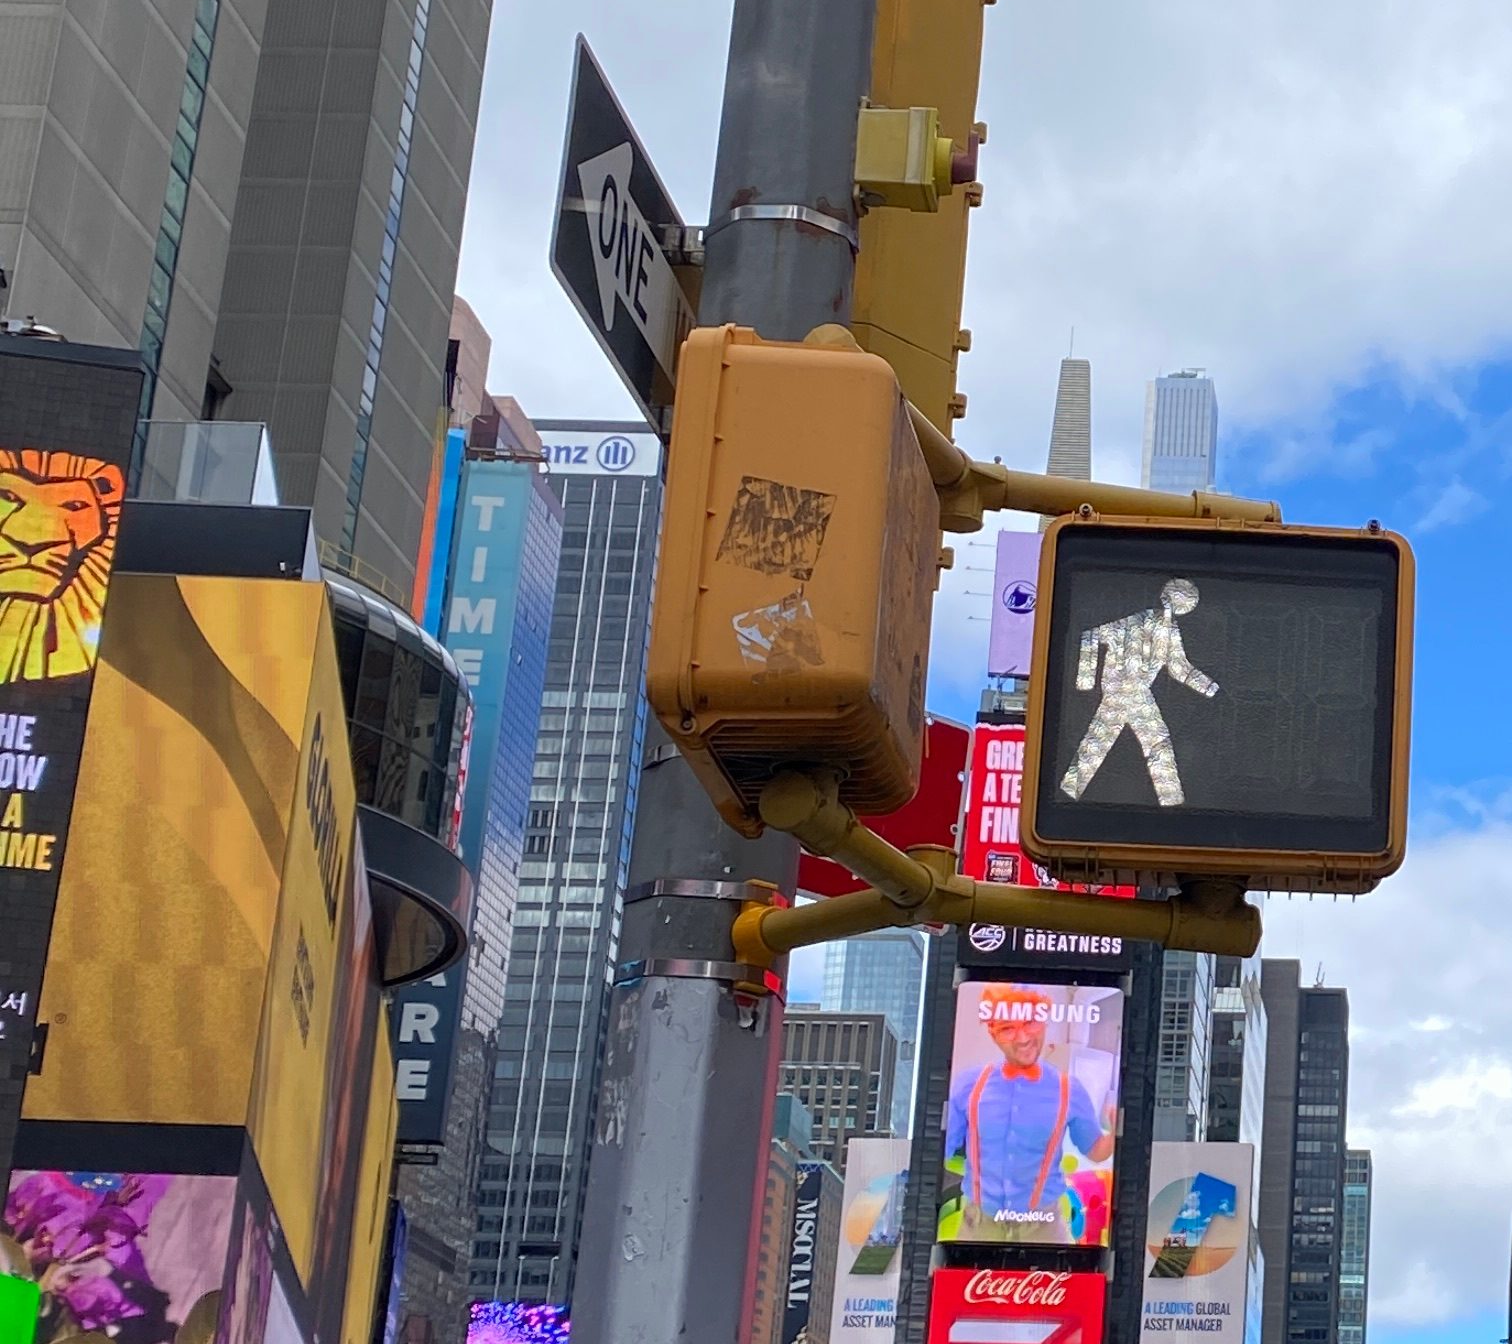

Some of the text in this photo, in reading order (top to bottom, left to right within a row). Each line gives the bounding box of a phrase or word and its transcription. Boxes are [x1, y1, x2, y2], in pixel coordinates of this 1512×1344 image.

[600, 174, 655, 325] ONE
[0, 713, 37, 752] HE
[986, 740, 1025, 771] GRE
[0, 752, 48, 791] OW
[982, 773, 1022, 803] ATE
[979, 807, 1021, 843] FIN
[0, 831, 57, 871] IME
[1024, 933, 1122, 955] GREATNESS
[978, 1000, 1101, 1024] SAMSUNG
[963, 1268, 1072, 1306] Coca-Cola
[852, 1299, 894, 1312] LEADING
[1145, 1302, 1231, 1316] A LEADING GLOBAL
[842, 1316, 897, 1329] ASSET MAN
[1143, 1318, 1223, 1332] ASSET MANAGER
